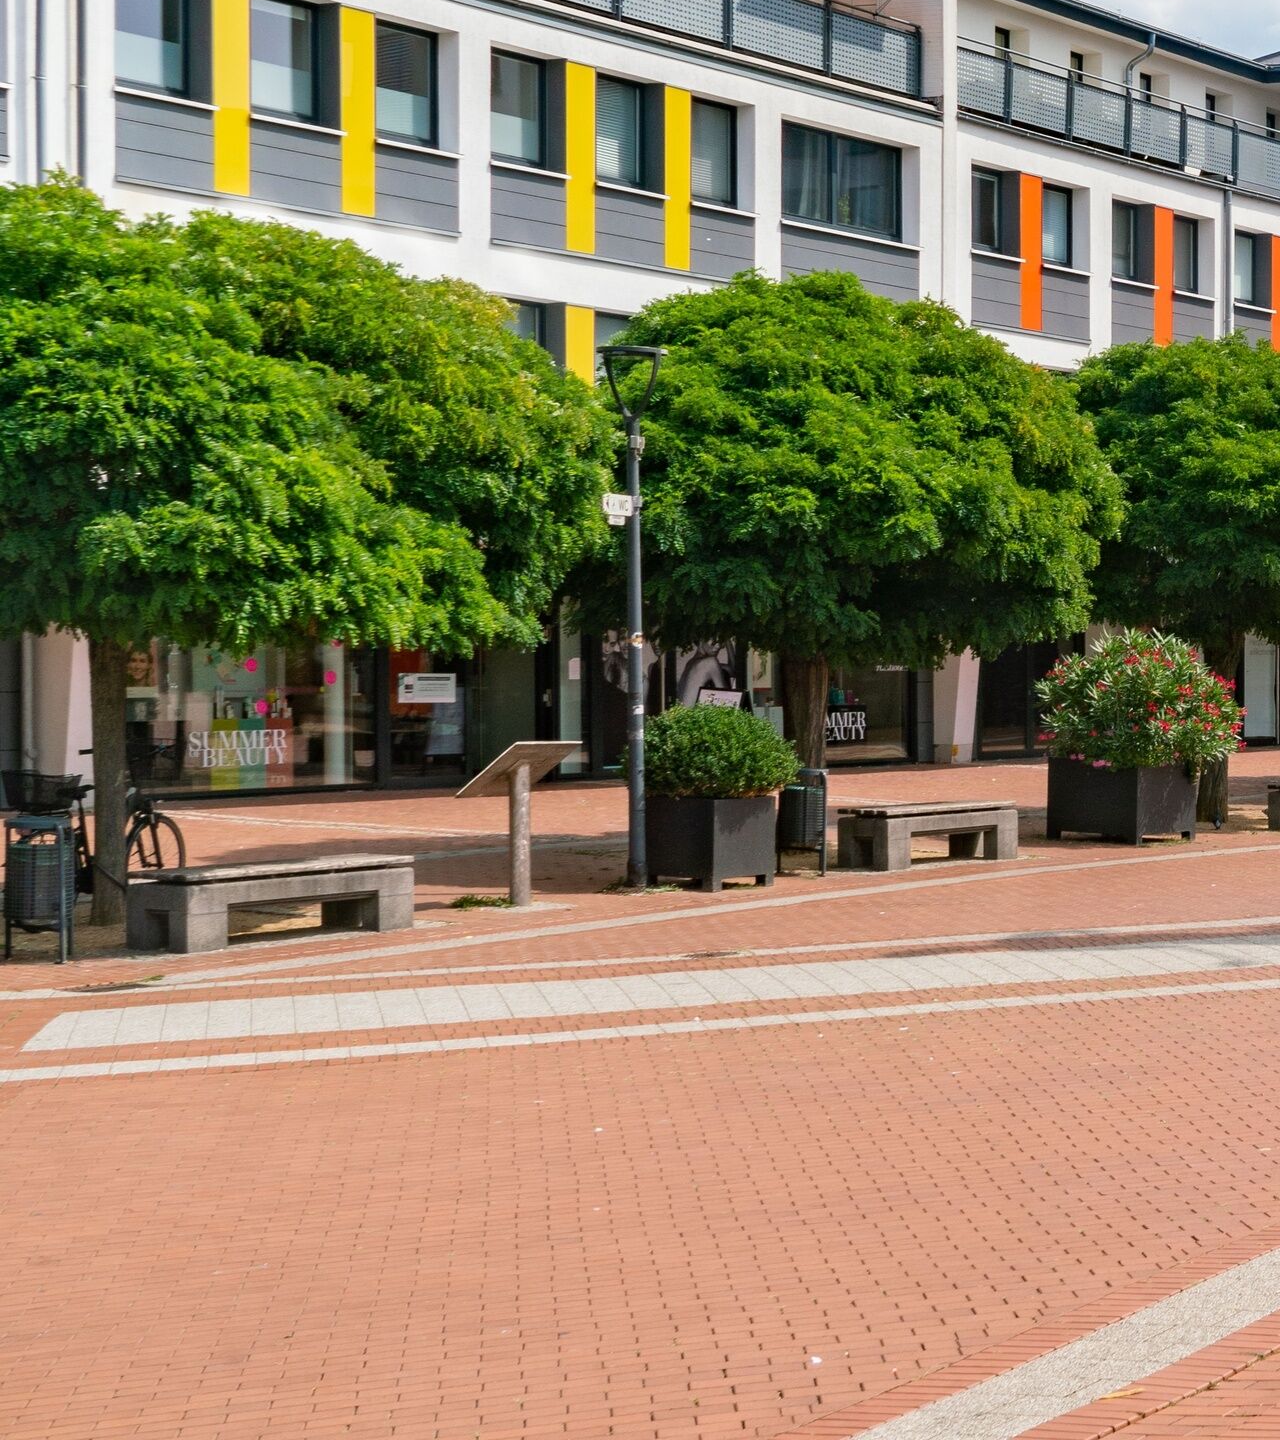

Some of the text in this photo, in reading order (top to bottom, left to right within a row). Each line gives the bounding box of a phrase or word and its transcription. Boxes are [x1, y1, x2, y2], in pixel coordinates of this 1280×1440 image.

[824, 711, 866, 728] MMER
[188, 728, 287, 752] SUMMER
[824, 725, 866, 741] EAUTY
[202, 746, 285, 768] BEAUTY
